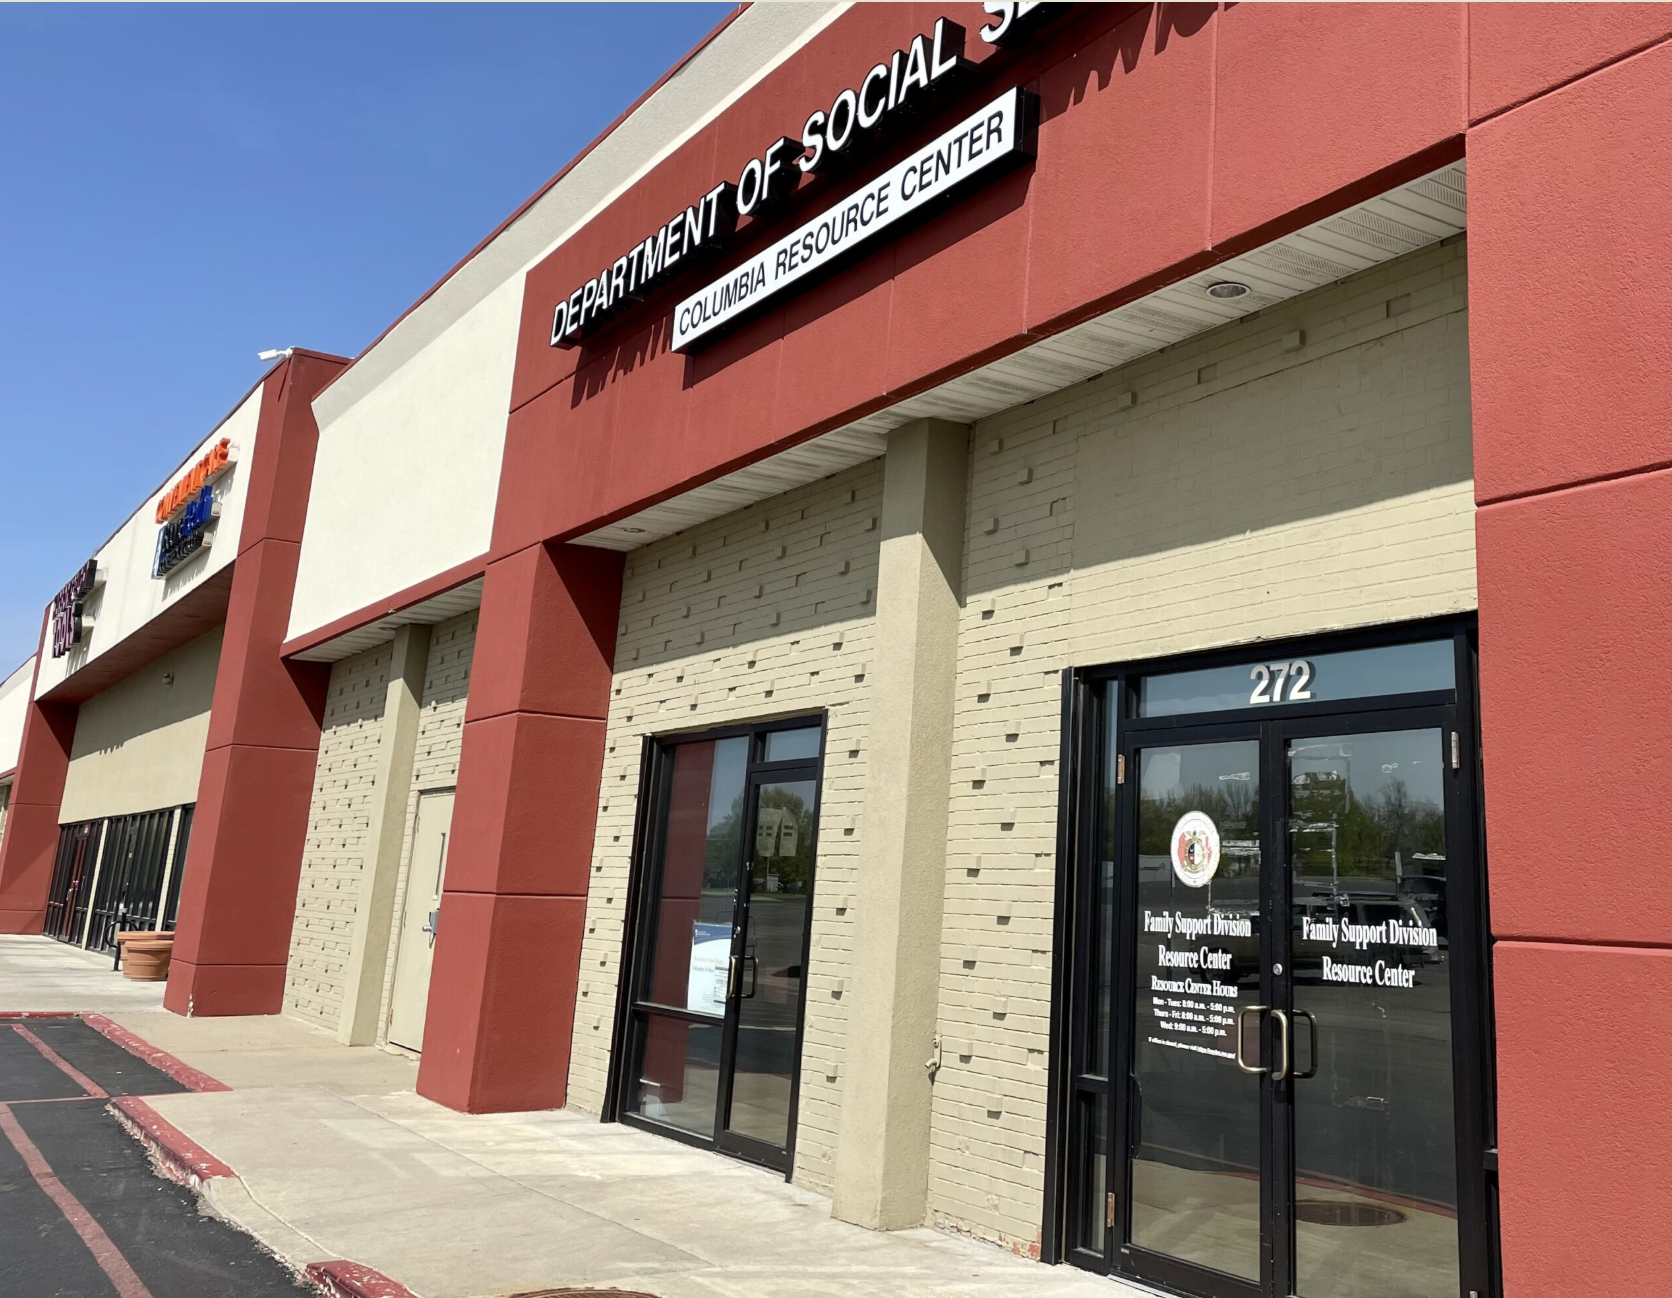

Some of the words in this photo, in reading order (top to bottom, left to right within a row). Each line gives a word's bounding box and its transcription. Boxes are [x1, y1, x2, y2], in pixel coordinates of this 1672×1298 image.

[549, 180, 726, 347] DEPARTMENT
[735, 136, 787, 216] OF
[799, 16, 959, 173] SOCIAL
[679, 261, 766, 336] COLUMBIA
[774, 182, 891, 279] RESOURCE
[900, 110, 1004, 202] CENTER
[1249, 660, 1312, 704] 272
[1143, 910, 1174, 939] Family
[1175, 911, 1212, 941] Support
[1212, 913, 1252, 937] Division
[1301, 916, 1341, 949] Family
[1341, 917, 1387, 950] Support
[1388, 919, 1438, 947] Division
[1157, 944, 1199, 969] Resource
[1199, 945, 1232, 970] Center
[1321, 956, 1373, 985] Resource
[1374, 960, 1416, 988] Center
[1150, 975, 1185, 993] RESOURCE
[1185, 977, 1212, 996] CENTER
[1212, 980, 1239, 998] HOURS
[1209, 1014, 1222, 1024] 5:00
[1210, 1003, 1223, 1012] 5:00
[1201, 1025, 1215, 1035] 5:00
